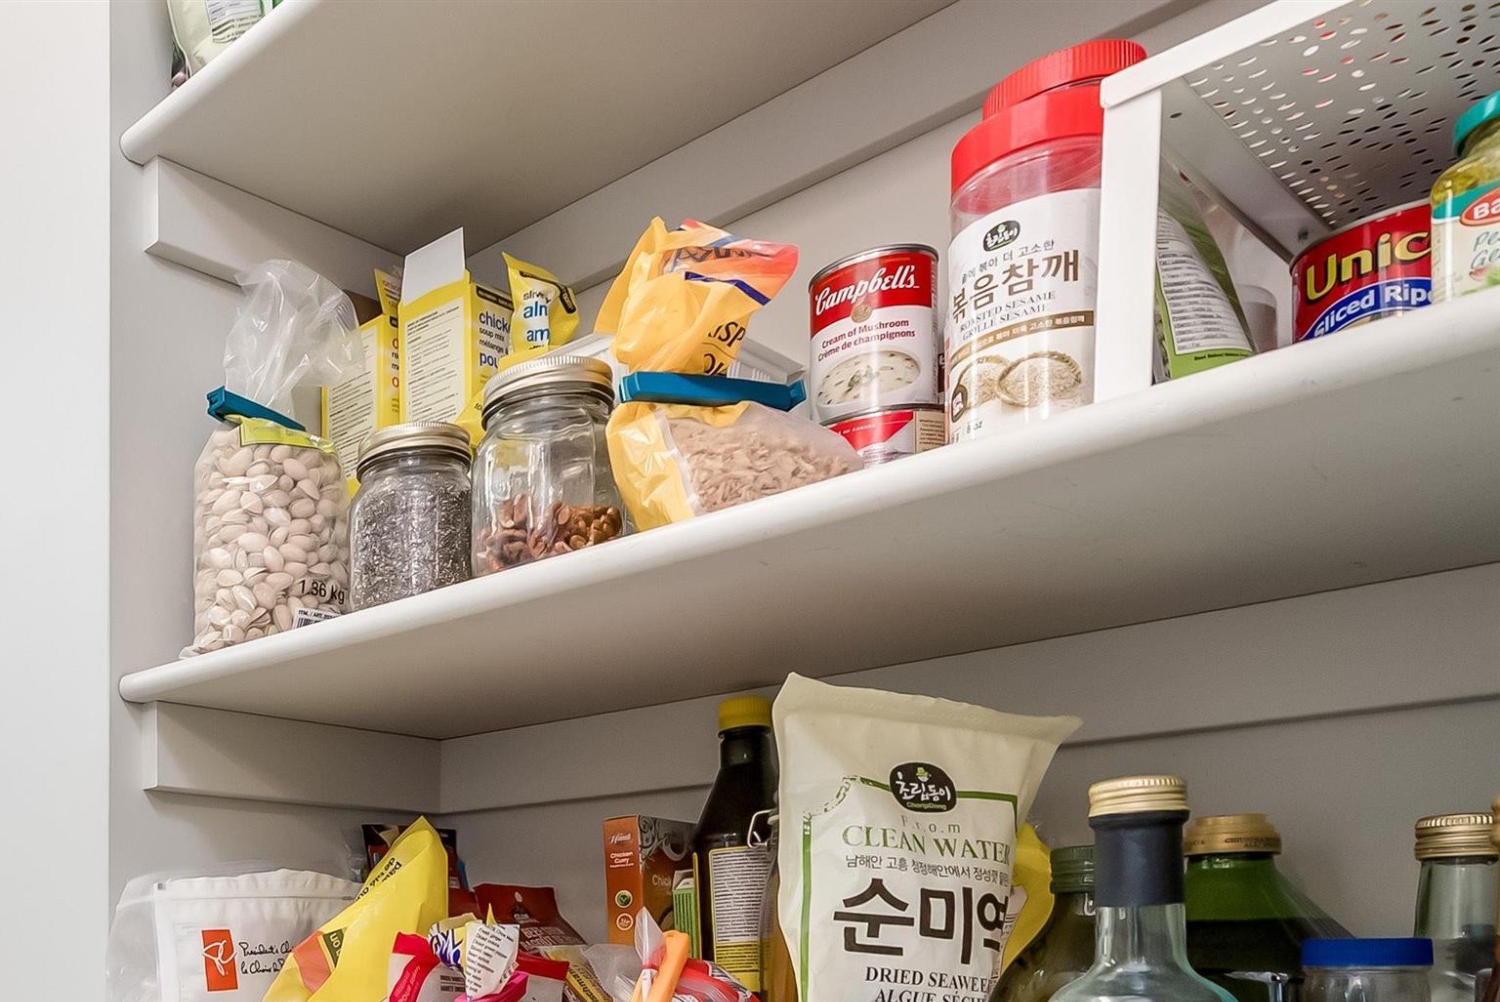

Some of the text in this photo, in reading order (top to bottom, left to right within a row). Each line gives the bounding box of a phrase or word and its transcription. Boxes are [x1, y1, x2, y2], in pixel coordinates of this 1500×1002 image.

[815, 265, 913, 316] Campbell's
[952, 249, 1079, 324] 볶음참깨
[960, 291, 1056, 332] ROASTED SESAME
[1314, 288, 1375, 337] Sliced
[479, 327, 505, 342] soup mix
[818, 330, 916, 362] Crème de champignons
[822, 319, 909, 349] Cream of Mushroom
[297, 579, 345, 605] 1.36 kg
[896, 770, 951, 802] 초립동이
[842, 825, 926, 855] CLEAN
[614, 857, 630, 865] Curry
[845, 854, 882, 870] 남해안
[865, 966, 923, 986] DRIED
